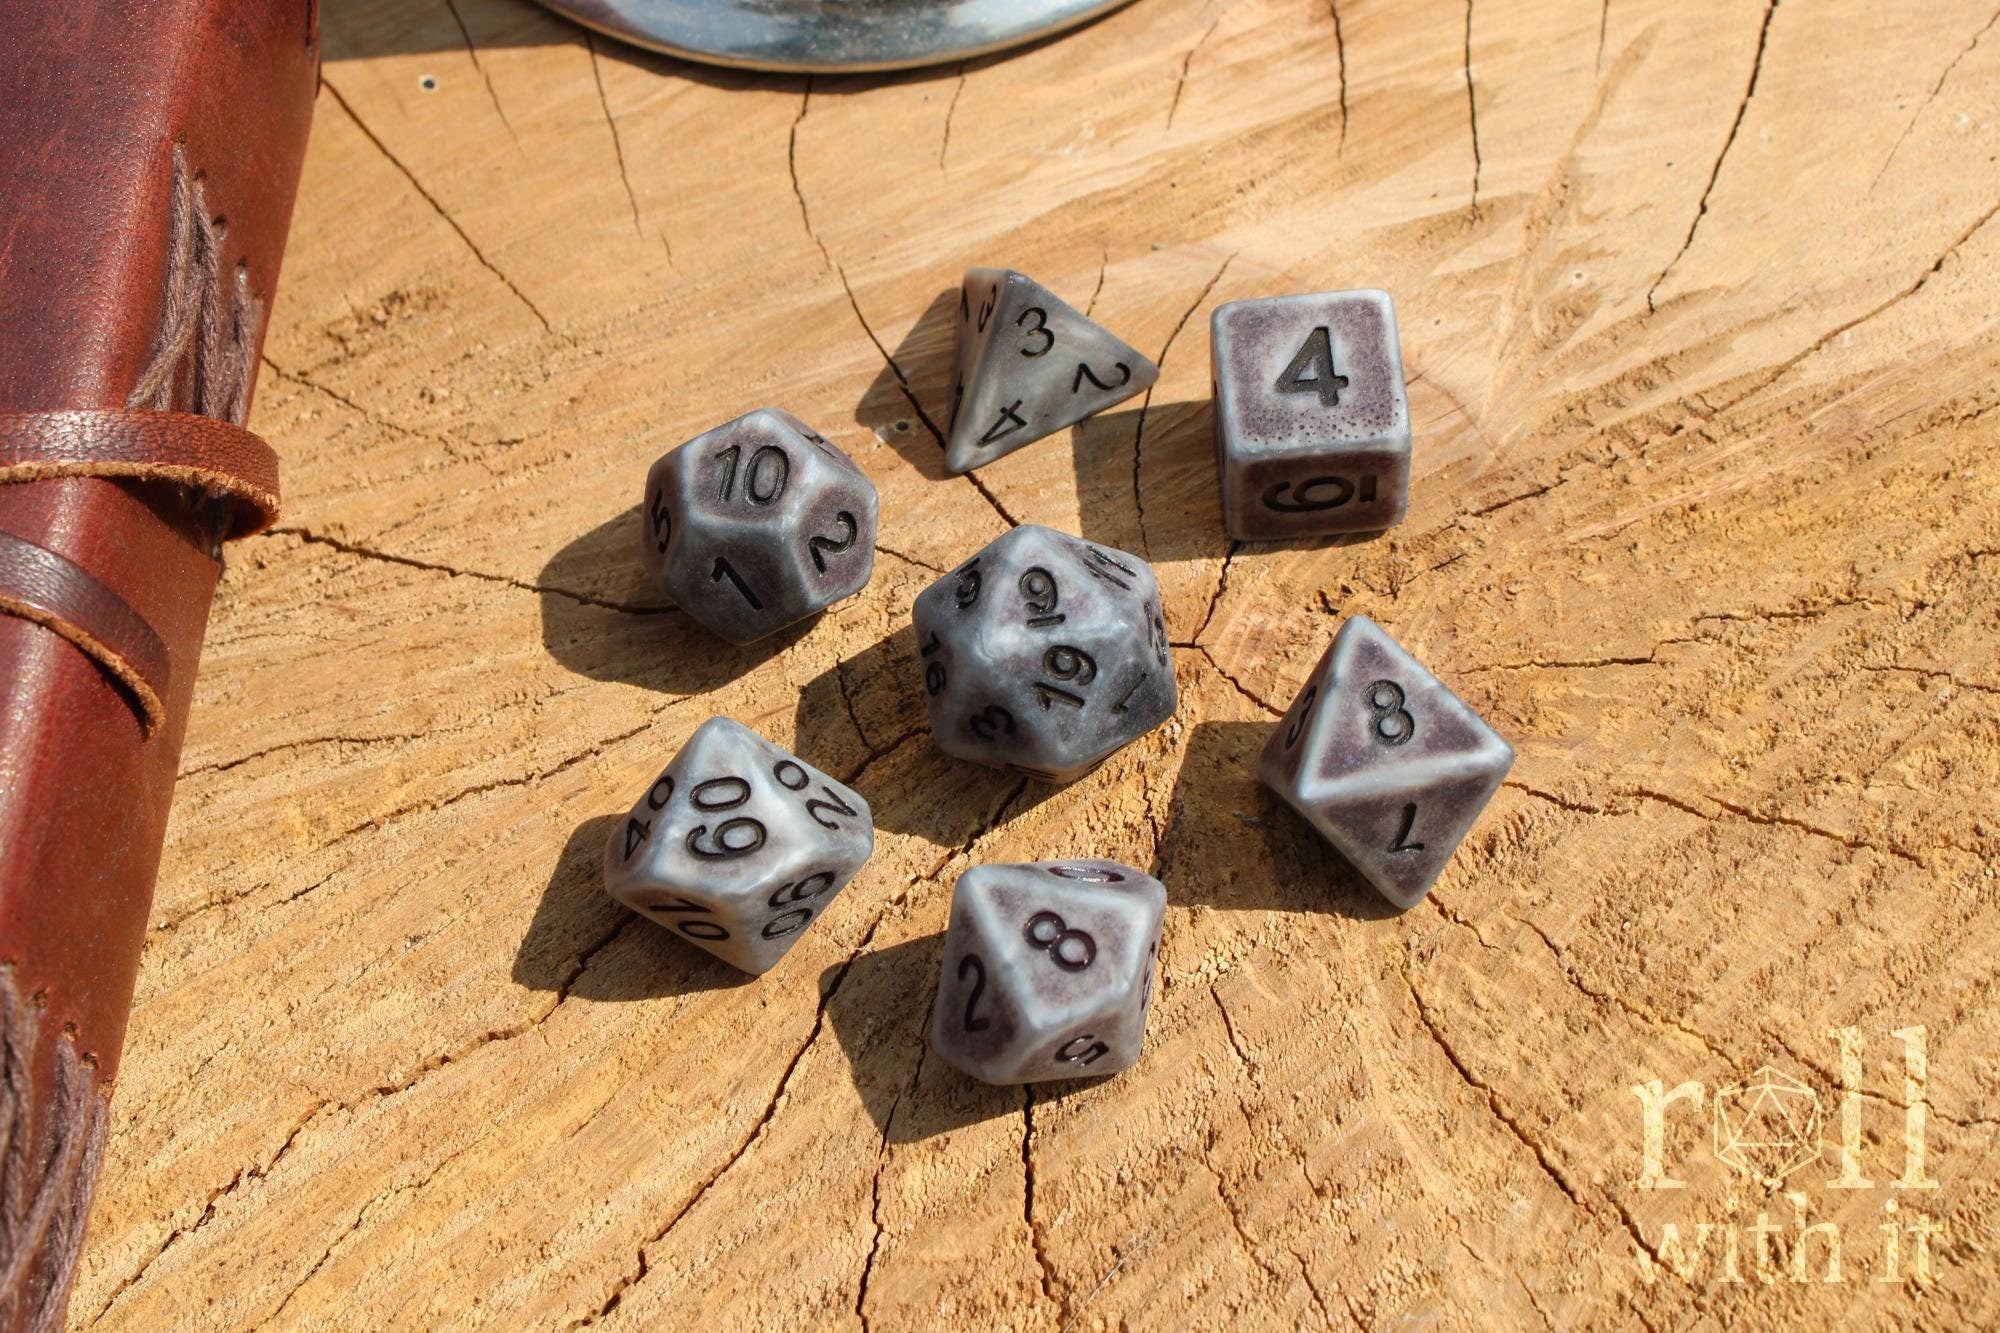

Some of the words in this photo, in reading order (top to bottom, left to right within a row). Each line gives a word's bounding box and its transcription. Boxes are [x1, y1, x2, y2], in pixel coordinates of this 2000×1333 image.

[1016, 307, 1055, 357] 3
[1072, 362, 1131, 393] 2
[1275, 326, 1348, 407] 4
[977, 400, 1028, 447] 4
[714, 444, 790, 507] 10
[651, 488, 672, 554] 5
[808, 510, 858, 575] 2
[710, 556, 764, 610] 1
[1032, 645, 1098, 712] 19
[1364, 679, 1415, 746] 8
[624, 775, 675, 862] 40
[686, 776, 768, 861] 60
[773, 760, 858, 830] 20
[1024, 910, 1097, 972] 8
[957, 953, 991, 1033] 2
[1055, 1034, 1109, 1068] 5
